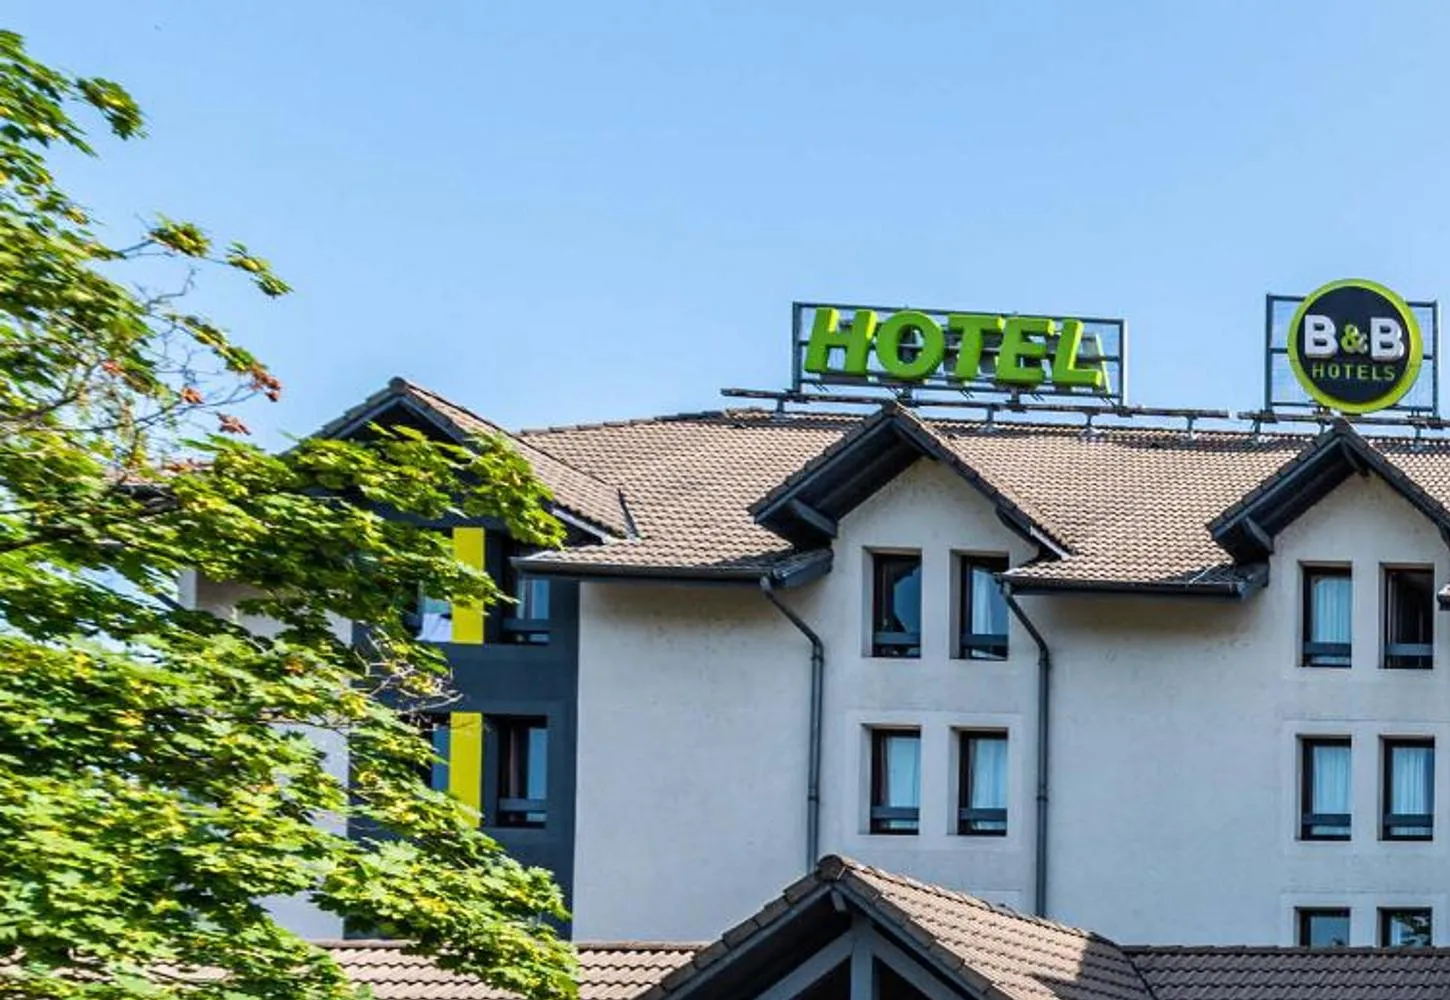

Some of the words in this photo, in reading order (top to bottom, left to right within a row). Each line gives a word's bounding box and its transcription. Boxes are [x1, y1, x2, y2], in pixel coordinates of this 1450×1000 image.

[804, 307, 1102, 388] HOTEL
[1304, 314, 1405, 360] B&B
[1312, 363, 1396, 381] HOTELS
